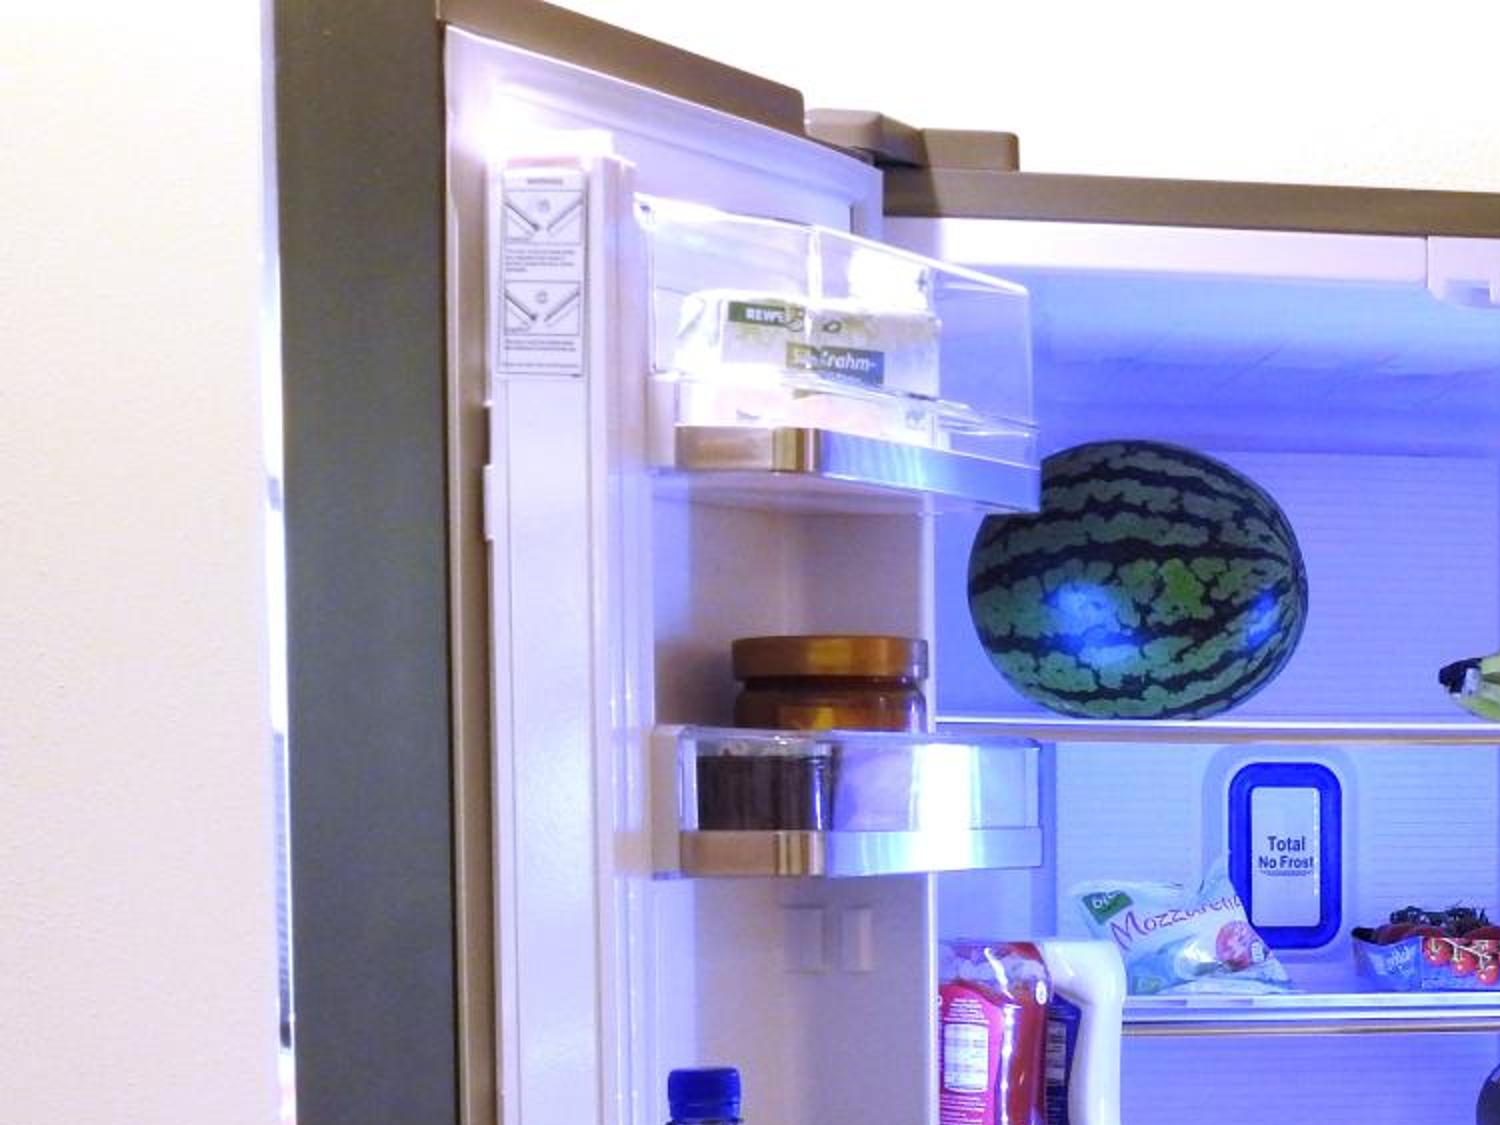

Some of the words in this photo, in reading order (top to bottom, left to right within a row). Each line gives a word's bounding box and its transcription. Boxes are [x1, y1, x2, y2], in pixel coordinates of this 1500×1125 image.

[1267, 836, 1306, 851] Total
[1258, 856, 1277, 869] No
[1279, 855, 1314, 869] Frost
